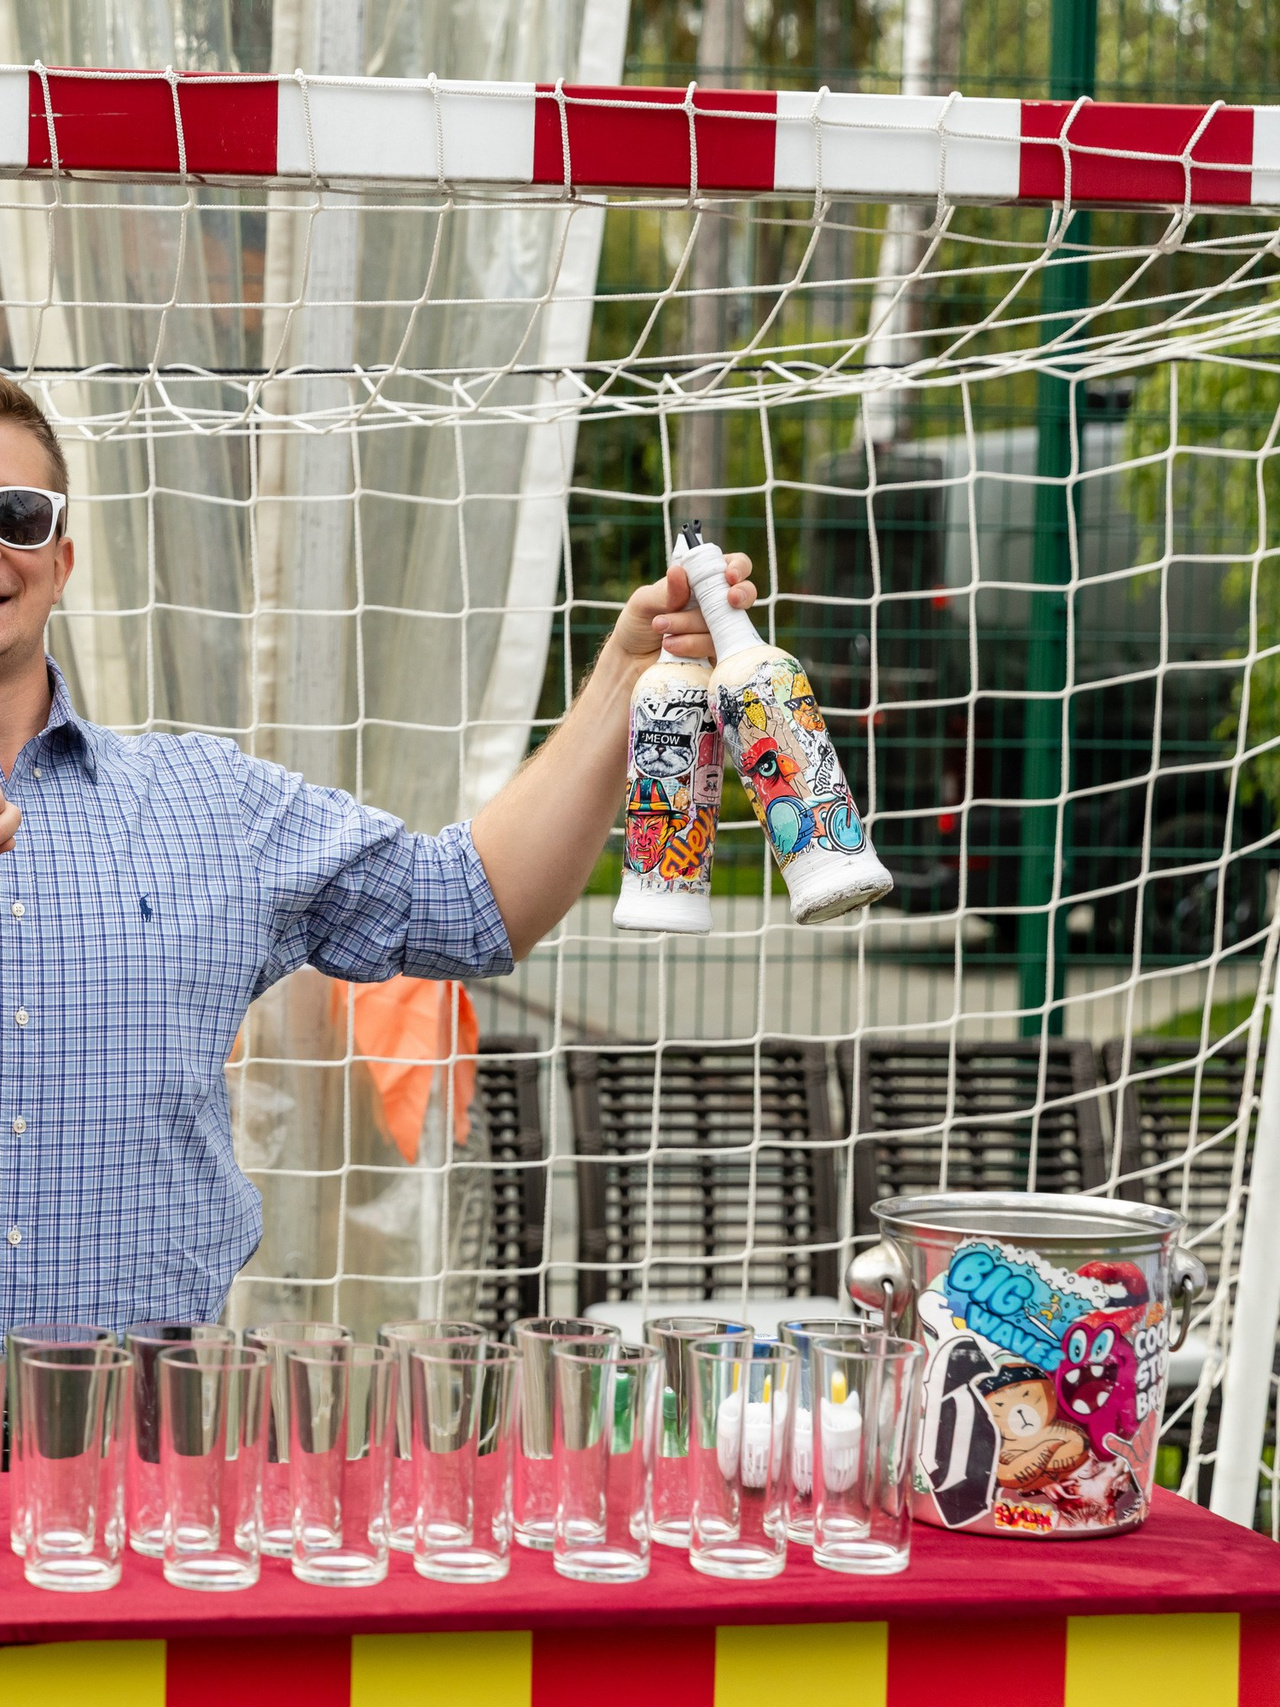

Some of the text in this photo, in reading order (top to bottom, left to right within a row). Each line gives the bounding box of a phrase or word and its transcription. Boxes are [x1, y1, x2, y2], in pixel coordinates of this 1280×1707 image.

[644, 732, 680, 745] MEOW
[948, 1252, 1034, 1317] BIG
[965, 1301, 1066, 1371] WAVES
[1014, 1446, 1075, 1484] NO WAY OUT
